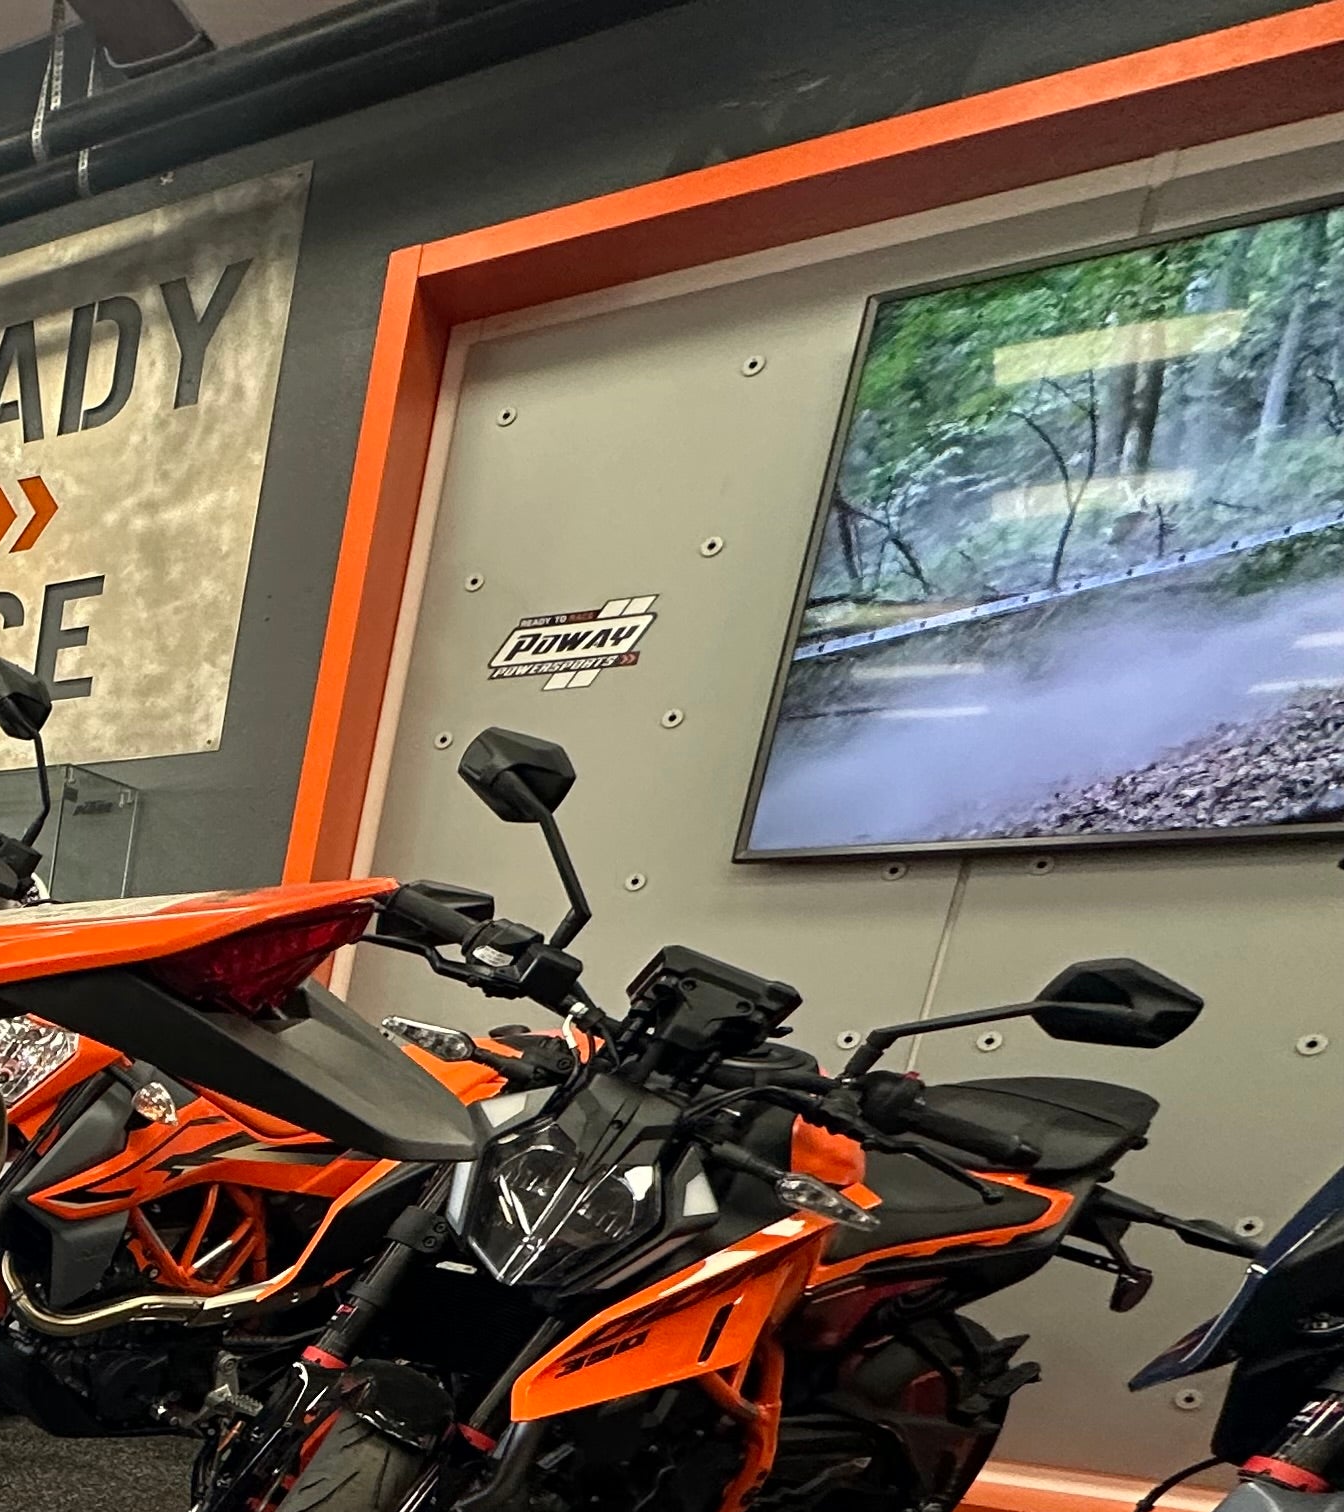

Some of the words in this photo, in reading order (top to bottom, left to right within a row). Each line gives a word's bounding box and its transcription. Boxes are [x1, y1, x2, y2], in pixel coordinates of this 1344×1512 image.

[521, 617, 551, 627] READY
[555, 616, 567, 624] TO
[504, 625, 640, 661] POWAY
[492, 655, 618, 678] POWERSPORTS
